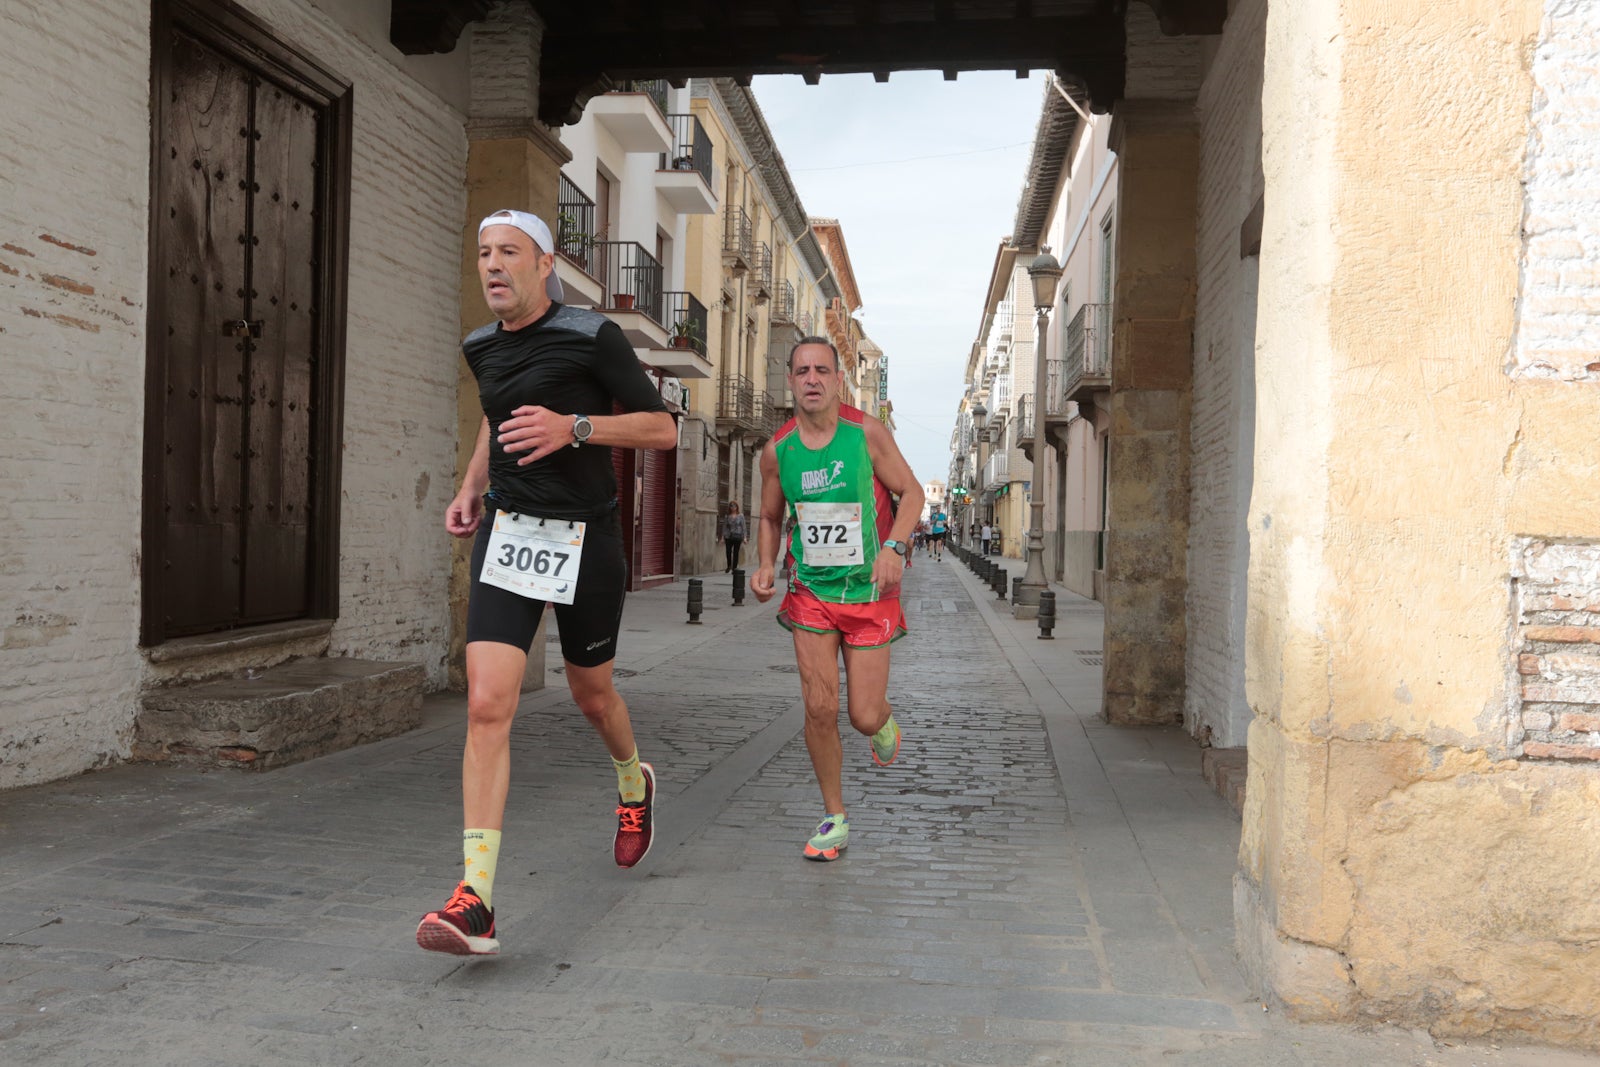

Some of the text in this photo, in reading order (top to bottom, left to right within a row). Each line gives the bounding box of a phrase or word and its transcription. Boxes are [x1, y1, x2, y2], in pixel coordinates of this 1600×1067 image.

[880, 356, 888, 399] TEJIDOS
[802, 468, 829, 490] ATARFE
[807, 525, 847, 544] 372
[497, 543, 570, 577] 3067
